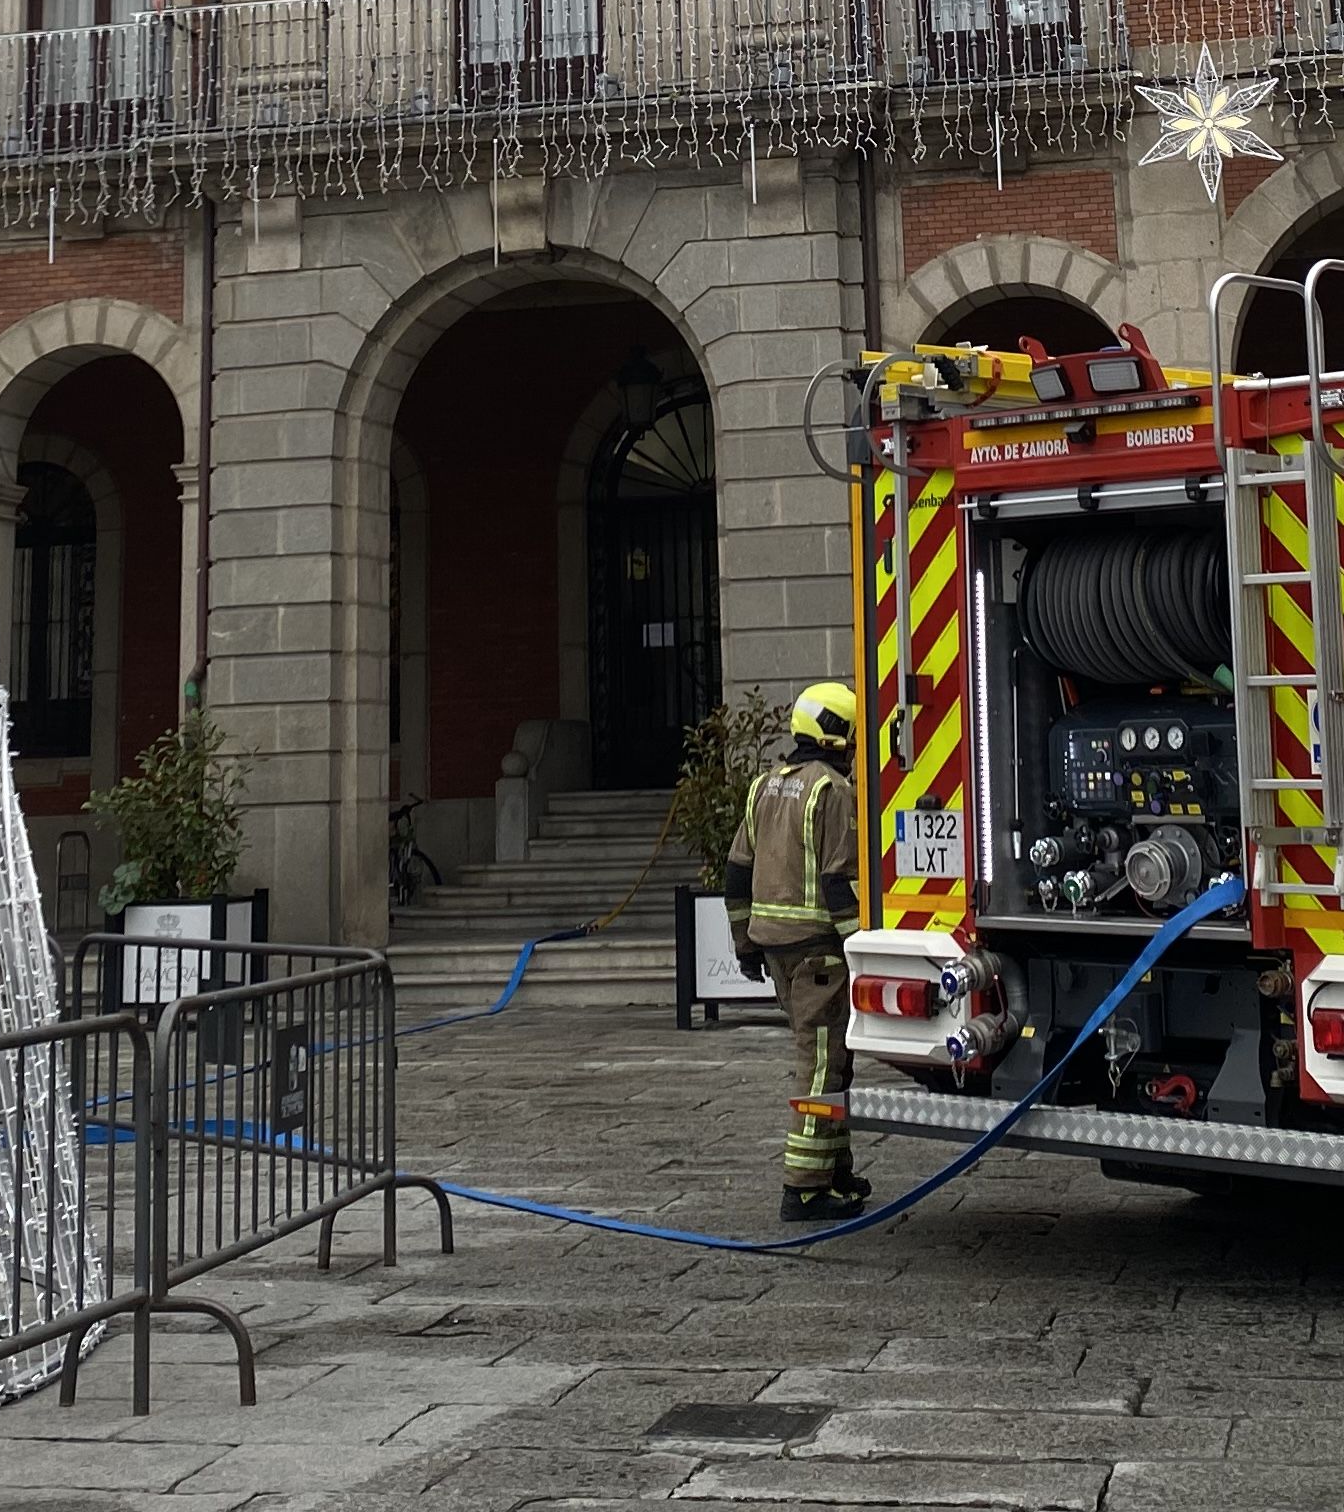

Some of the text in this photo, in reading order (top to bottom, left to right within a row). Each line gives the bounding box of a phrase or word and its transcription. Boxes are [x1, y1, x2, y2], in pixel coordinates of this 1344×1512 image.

[1126, 425, 1194, 447] BOMBEROS
[971, 439, 1069, 464] AYTO. DE ZAMORA
[914, 814, 957, 839] 1322
[914, 847, 947, 873] LXT
